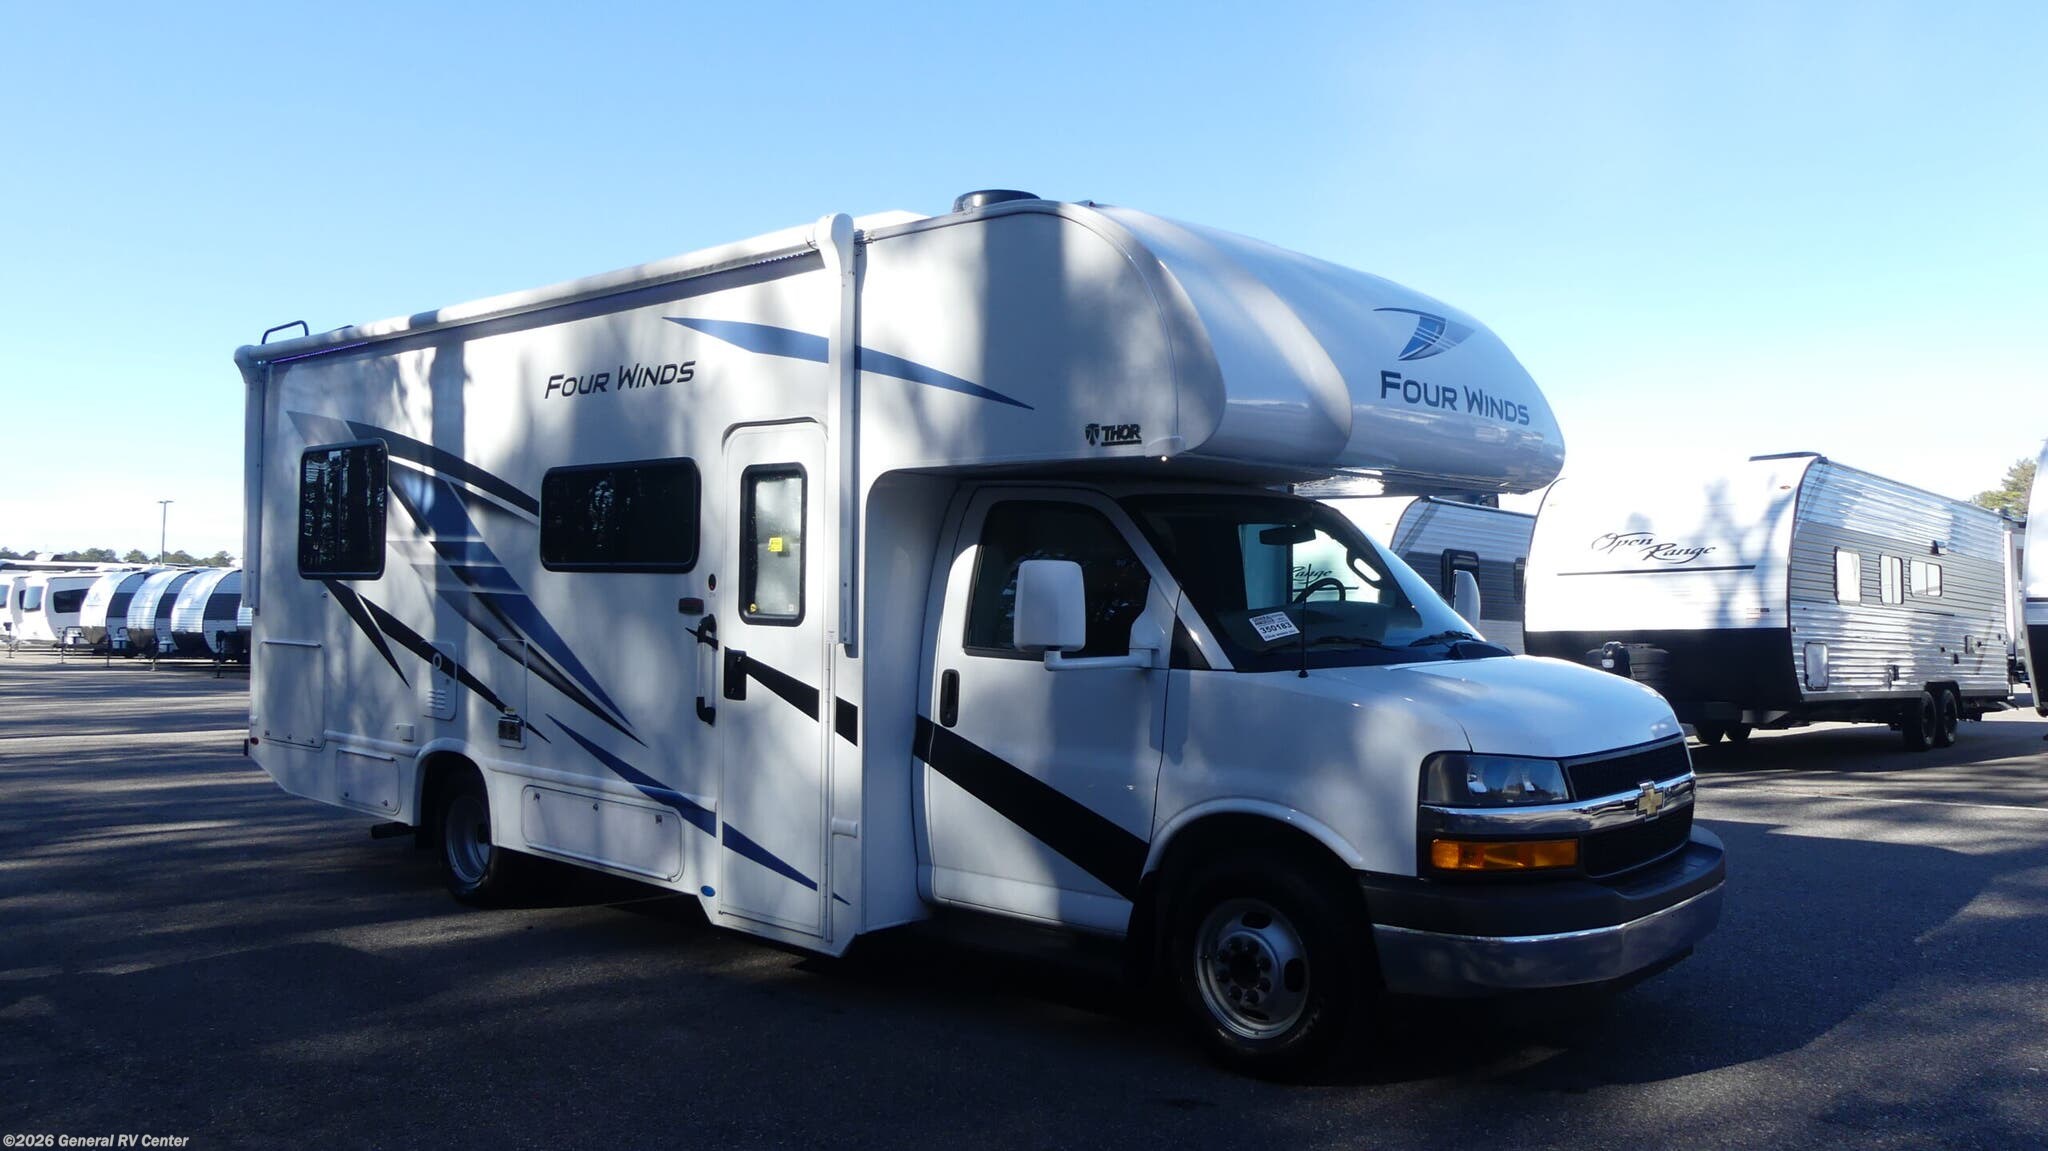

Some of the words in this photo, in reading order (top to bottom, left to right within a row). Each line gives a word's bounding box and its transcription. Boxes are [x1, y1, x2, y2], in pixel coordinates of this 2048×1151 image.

[545, 372, 610, 399] FOUR
[617, 360, 696, 391] WINDS
[1380, 370, 1458, 411] FOUR
[1463, 385, 1530, 426] WINDS
[1101, 423, 1142, 441] THOR
[1592, 531, 1656, 554] Open
[1638, 542, 1716, 565] Range
